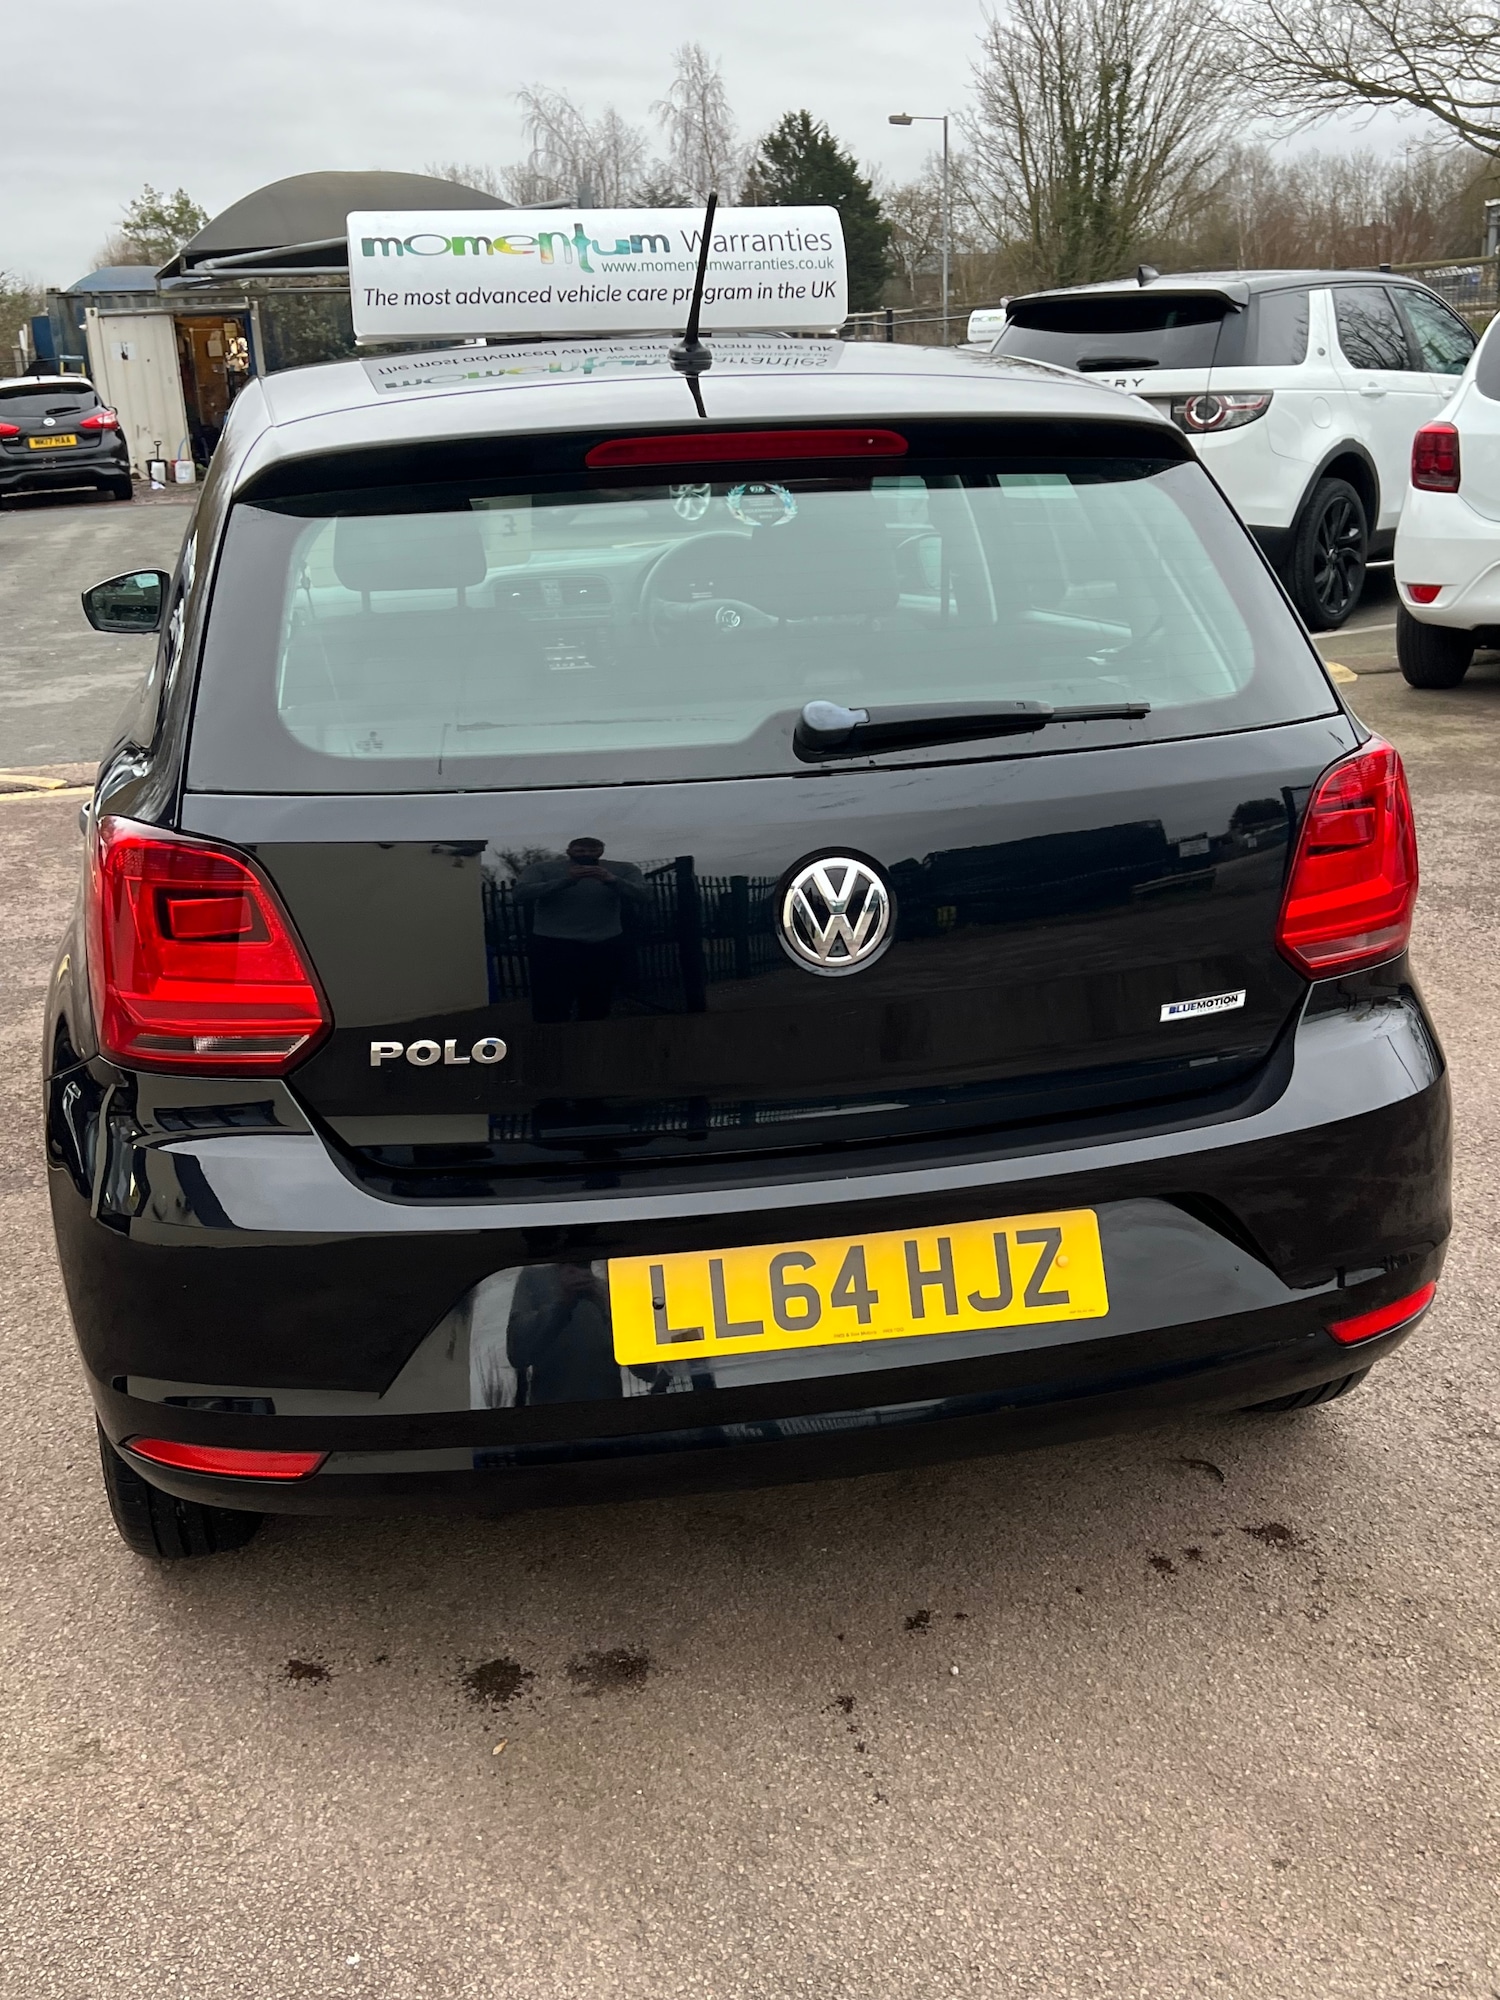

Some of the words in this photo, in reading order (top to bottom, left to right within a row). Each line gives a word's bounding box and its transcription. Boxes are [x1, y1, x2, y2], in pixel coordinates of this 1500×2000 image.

[361, 223, 671, 273] momentum
[680, 228, 833, 253] Warranties
[364, 288, 398, 306] The
[404, 290, 451, 305] most
[456, 286, 551, 304] advanced
[557, 284, 622, 303] vehicle
[626, 287, 668, 302] care
[673, 286, 752, 305] prgram
[757, 282, 774, 299] in
[777, 281, 806, 299] the
[811, 280, 837, 298] UK
[1101, 377, 1144, 388] RY
[1168, 994, 1239, 1014] BLUEMOTION
[370, 1037, 507, 1067] POLO
[649, 1244, 879, 1345] LL64
[904, 1226, 1071, 1319] HJZ
